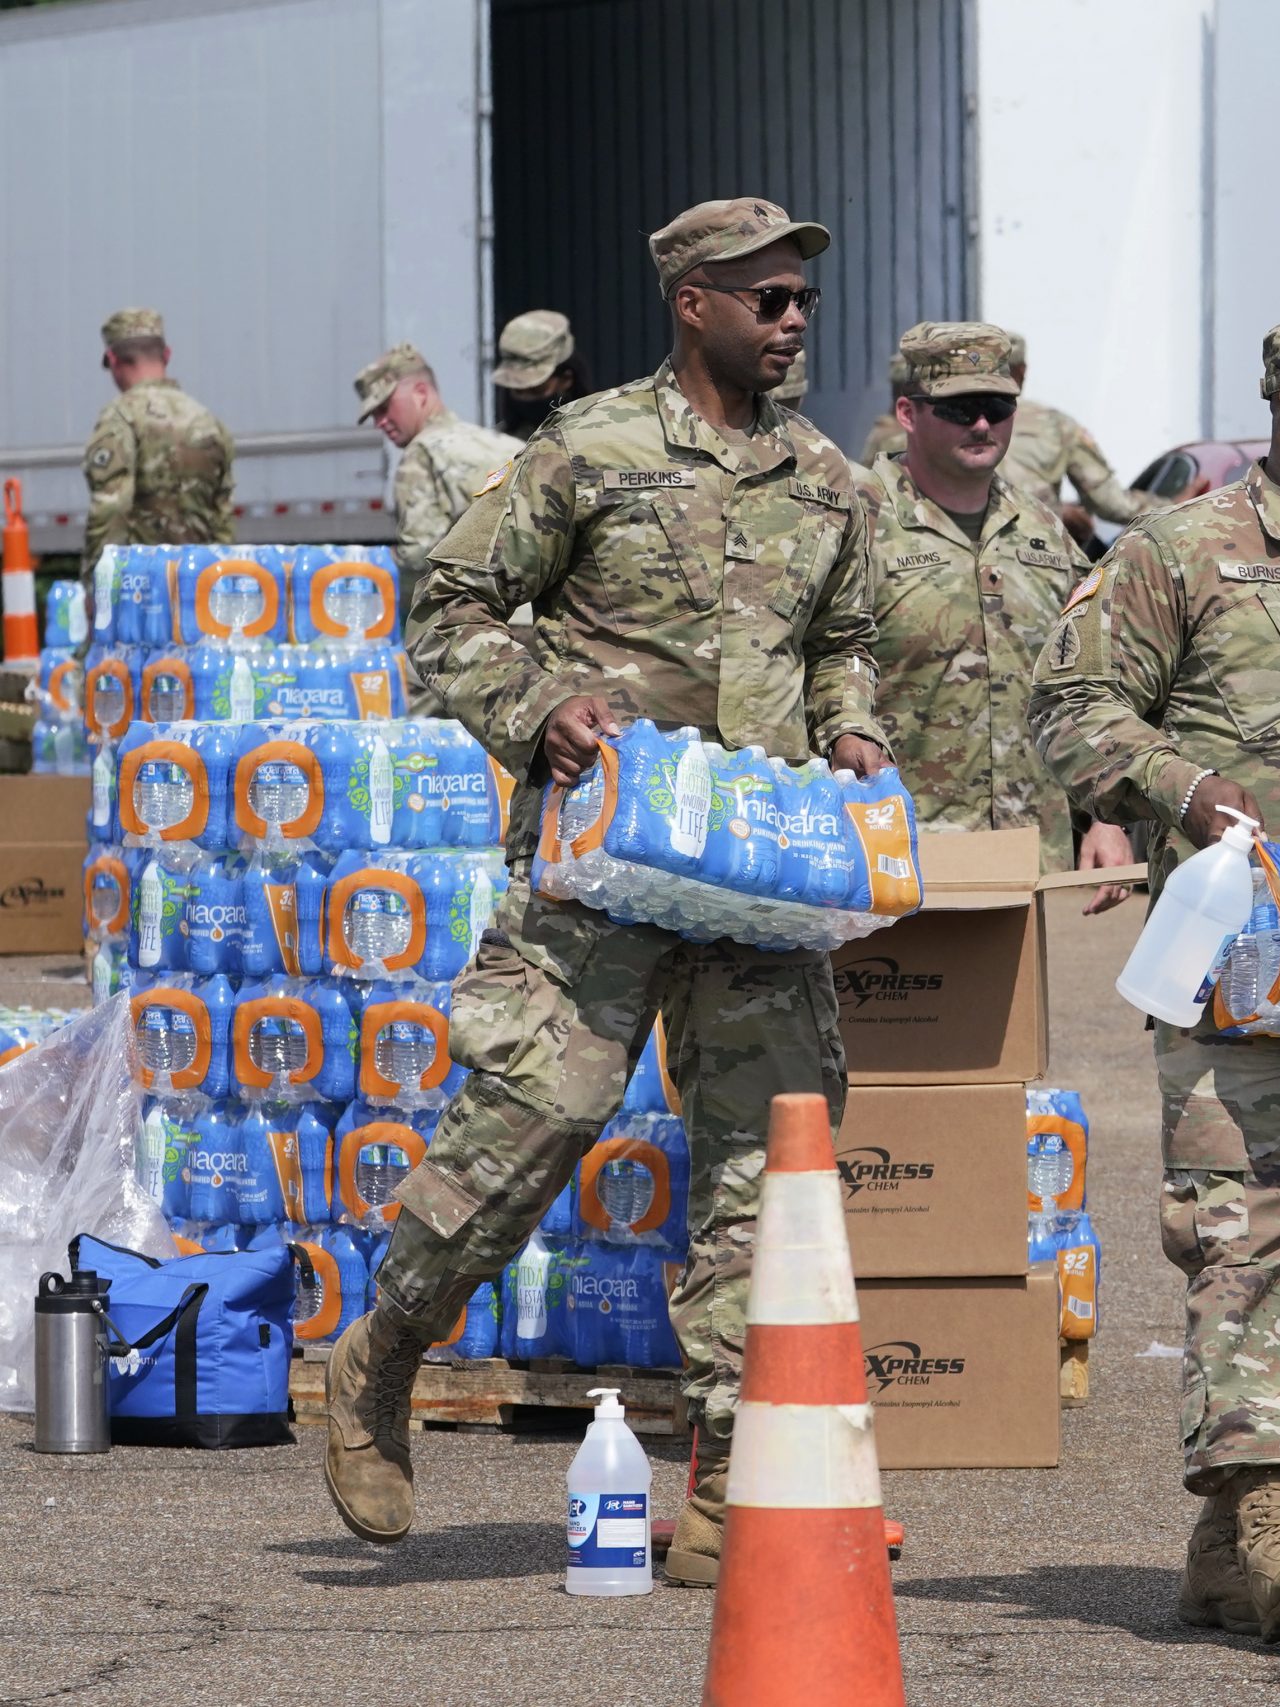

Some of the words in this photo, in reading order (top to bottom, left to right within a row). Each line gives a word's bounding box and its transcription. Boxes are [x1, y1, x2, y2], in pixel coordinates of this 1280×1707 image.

[618, 470, 683, 486] PERKINS
[795, 484, 815, 499] U.S.
[816, 486, 841, 505] ARMY
[896, 552, 941, 568] NATIONS
[1038, 554, 1062, 567] ARMY
[360, 676, 384, 690] 32
[276, 687, 344, 706] niagara
[417, 772, 487, 797] niagara
[742, 798, 839, 836] niagara
[864, 804, 895, 824] 32
[679, 808, 705, 844] LIFE
[792, 839, 825, 851] DRINKING
[186, 904, 248, 925] niagara
[875, 991, 909, 1001] CHEM
[913, 1015, 939, 1024] Alcohol
[188, 1150, 249, 1172] niagara
[836, 1160, 935, 1184] XPRESS
[866, 1181, 900, 1192] CHEM
[845, 1206, 870, 1214] ontains
[904, 1205, 930, 1213] Alcohol
[1063, 1252, 1089, 1270] 32
[572, 1276, 639, 1298] niagara
[525, 1289, 543, 1305] ESTA
[864, 1355, 966, 1377] XPRESS
[897, 1375, 930, 1385] CHEM
[934, 1399, 961, 1407] Alcohol
